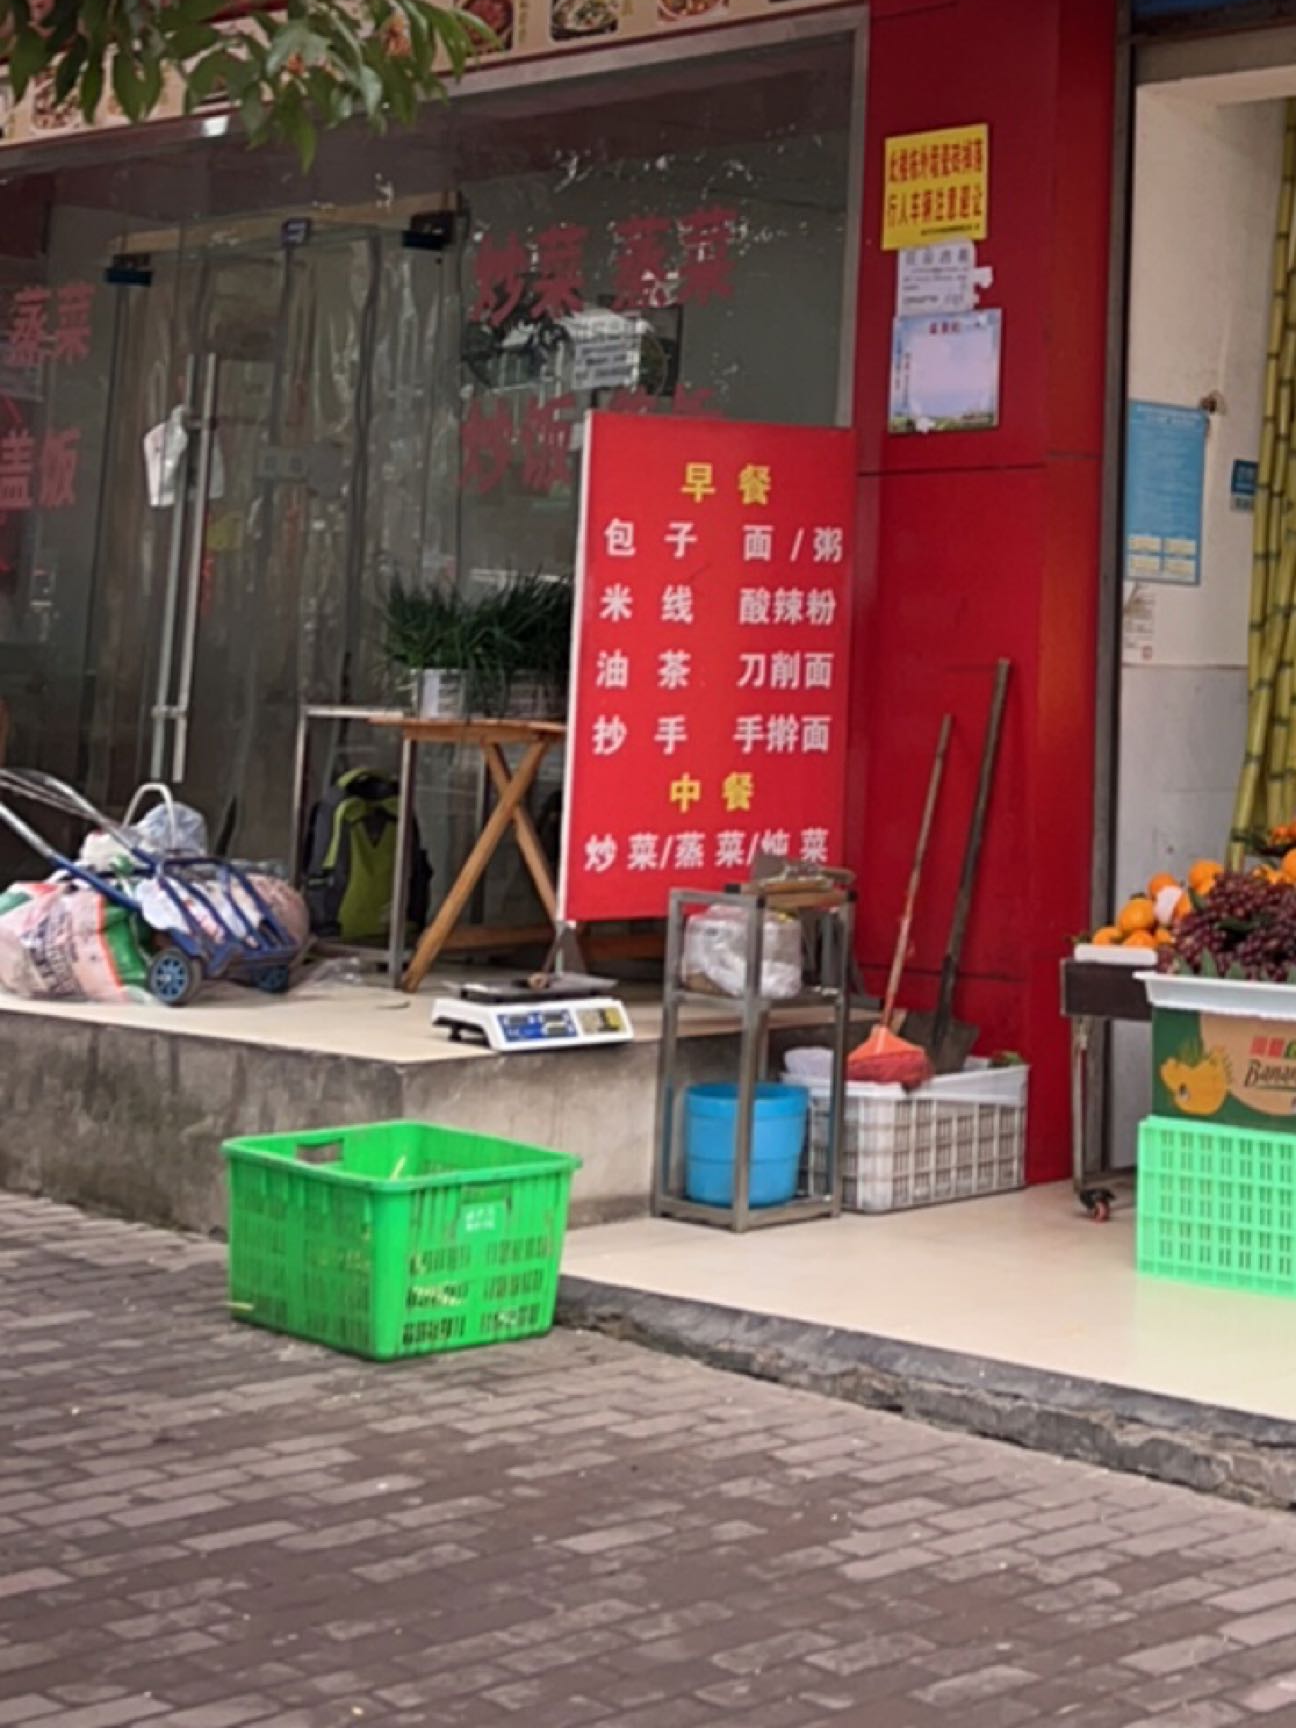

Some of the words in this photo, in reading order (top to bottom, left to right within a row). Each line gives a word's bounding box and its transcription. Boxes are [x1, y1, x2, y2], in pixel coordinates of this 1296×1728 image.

[680, 462, 772, 505] 早餐
[604, 517, 698, 560] 包子
[600, 583, 694, 623] 米线
[738, 588, 837, 625] 酸辣粉
[596, 648, 692, 689] 油茶
[736, 650, 835, 690] 刀削面
[592, 714, 688, 755] 抄手
[733, 714, 832, 755] 手擀面
[669, 772, 755, 813] 中餐
